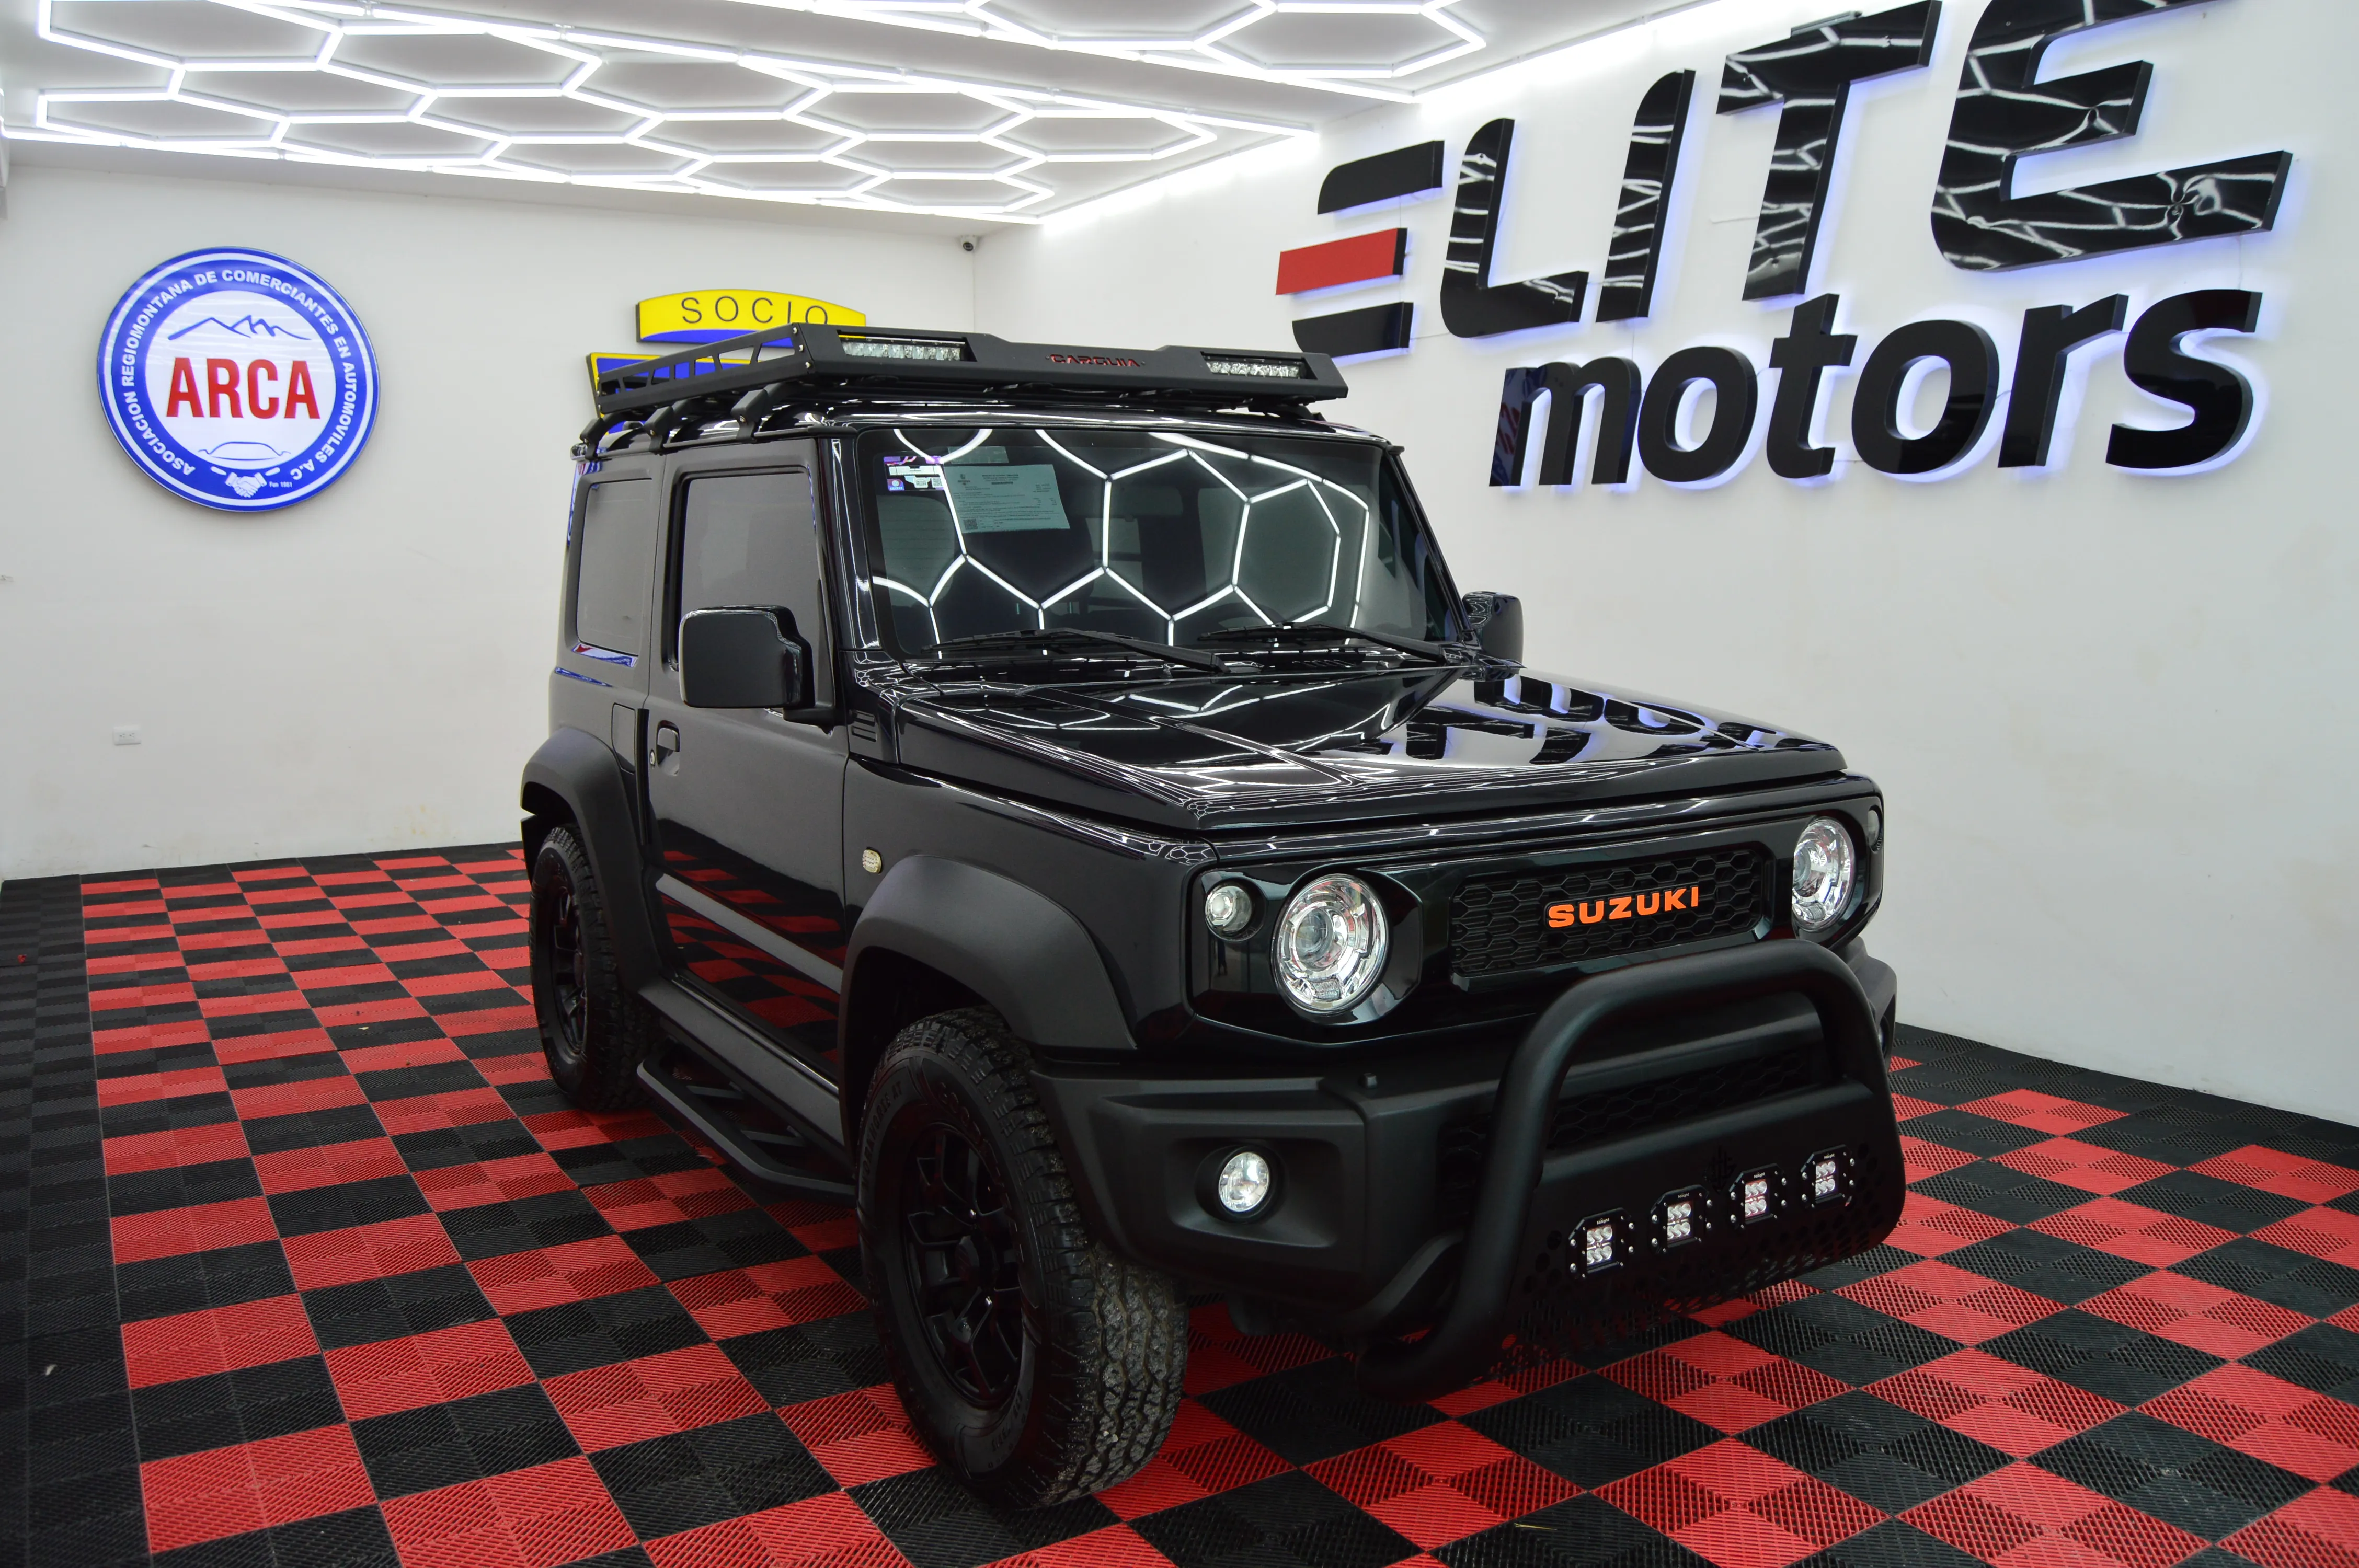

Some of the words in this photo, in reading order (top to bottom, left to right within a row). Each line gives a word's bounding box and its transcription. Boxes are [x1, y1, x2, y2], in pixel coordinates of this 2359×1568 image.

[1276, 0, 2292, 358] ELITE
[193, 270, 218, 286] DE
[222, 269, 339, 335] COMERCIANTES
[682, 296, 828, 324] SOCIO
[121, 279, 193, 386] REGIOMONTANA
[333, 336, 351, 359] EN
[166, 358, 320, 419] ARCA
[315, 362, 357, 463] AUTOMOVILES
[1489, 289, 2263, 487] motors
[123, 391, 196, 475] ASOCIACION
[1548, 886, 1700, 928] SUZUKI
